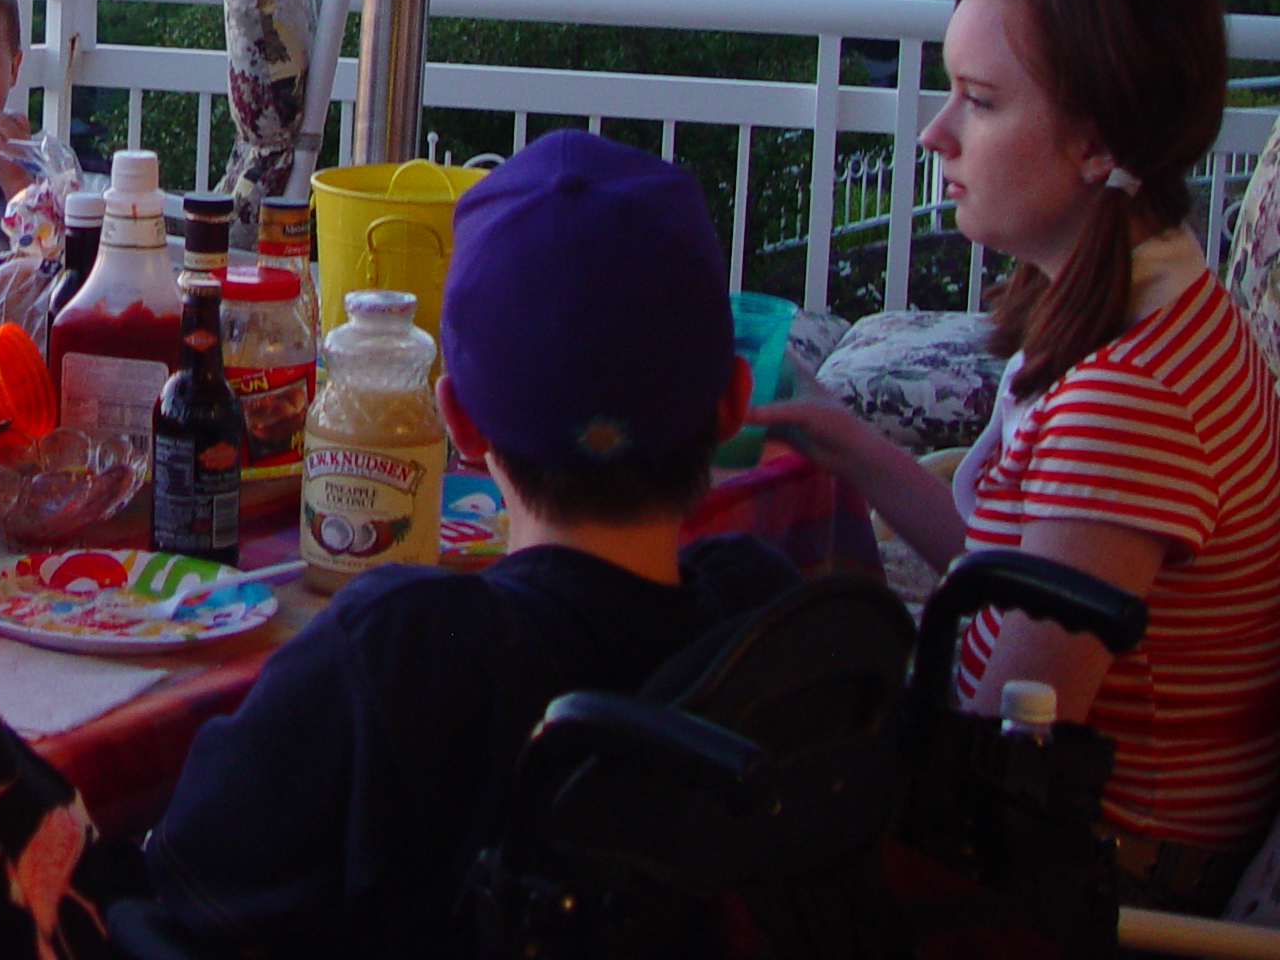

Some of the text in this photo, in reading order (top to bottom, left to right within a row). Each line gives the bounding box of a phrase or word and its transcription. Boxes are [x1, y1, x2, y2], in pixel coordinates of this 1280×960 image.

[329, 451, 410, 482] KNUDSEN
[325, 481, 377, 498] PINEAPPLE
[326, 494, 375, 508] COCONUT
